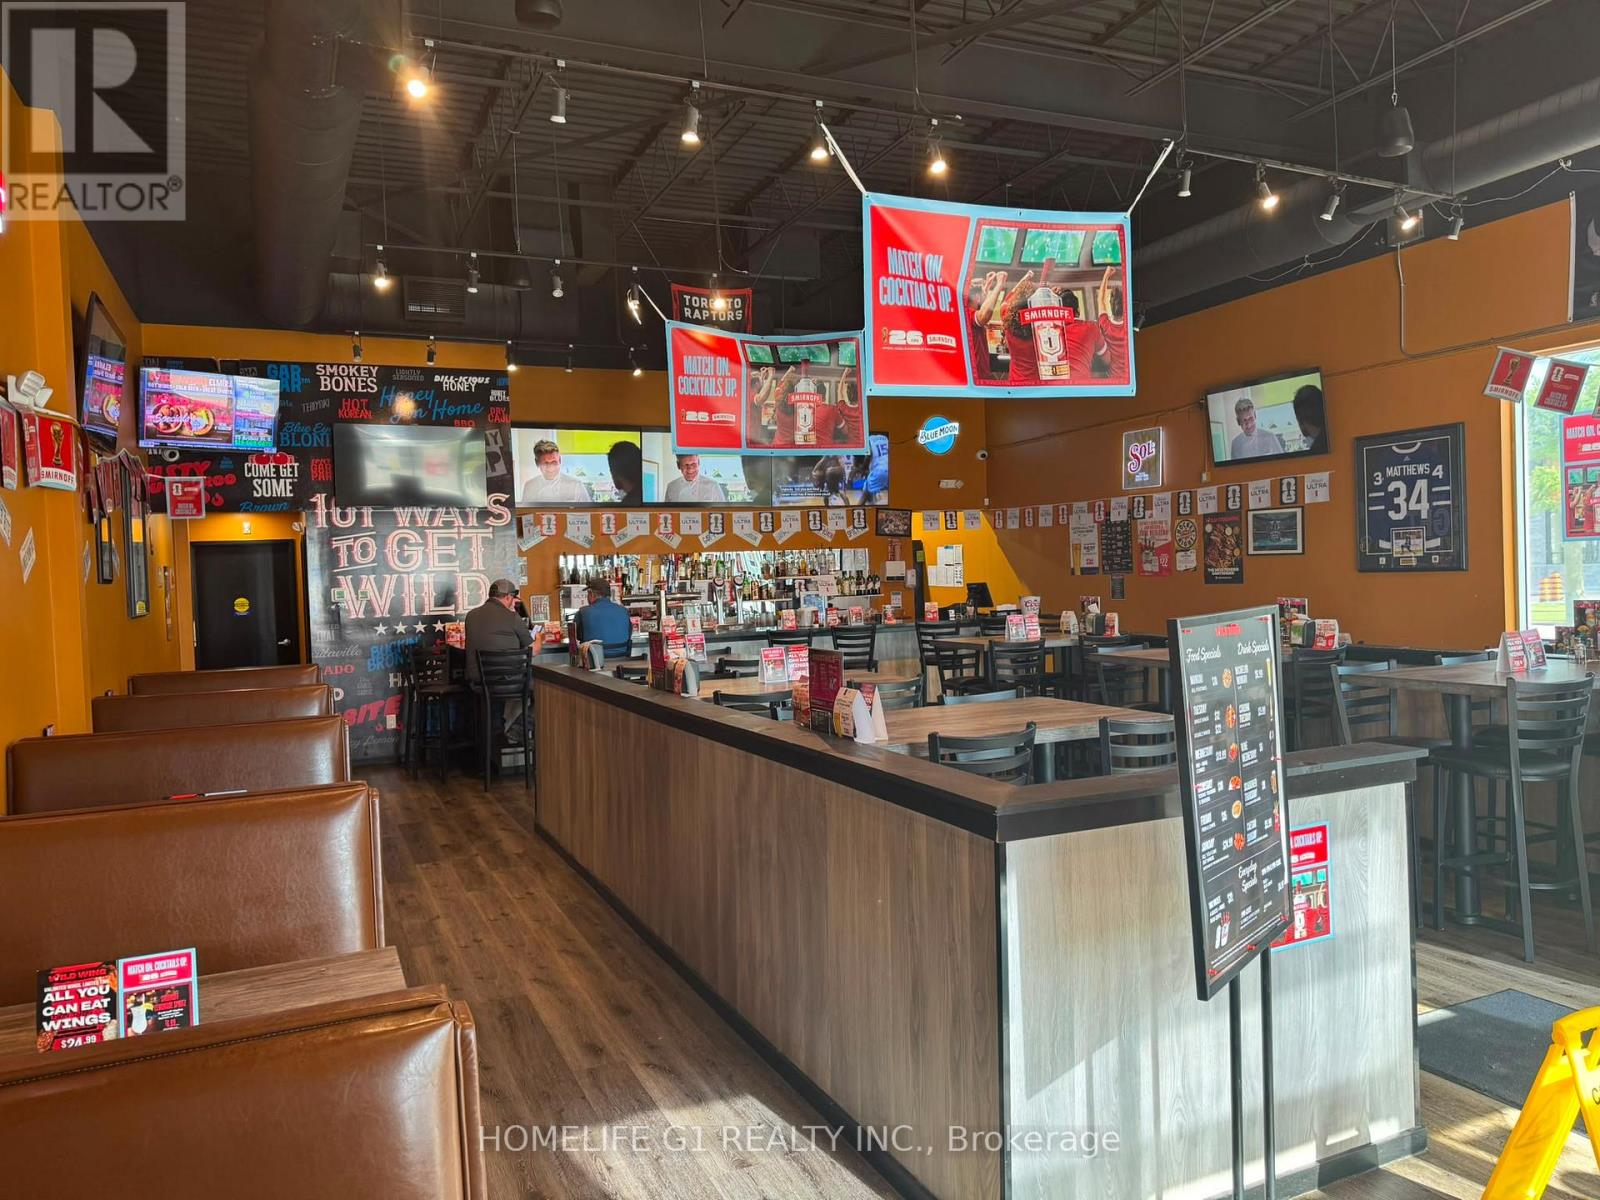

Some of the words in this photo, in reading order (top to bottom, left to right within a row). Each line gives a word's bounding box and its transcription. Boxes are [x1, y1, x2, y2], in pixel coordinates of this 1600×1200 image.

[887, 246, 922, 280] MATCH
[925, 253, 944, 283] ON.
[683, 294, 742, 309] TOROTO
[879, 276, 937, 310] COCKTAILS
[936, 286, 954, 313] UP.
[684, 307, 743, 321] RAPTORS
[315, 364, 379, 378] SMOKEY
[683, 355, 714, 376] MATCH
[319, 377, 379, 393] BONES
[442, 381, 477, 392] HONEY
[678, 375, 723, 397] COCKTAILS
[1489, 384, 1521, 399] SMIRNOFF
[341, 398, 369, 410] HOT
[432, 399, 484, 420] Home
[338, 409, 373, 419] KOREAN
[938, 424, 958, 438] MOON
[40, 470, 74, 484] SMIRNOFF
[244, 462, 277, 477] COME
[280, 462, 300, 477] GET
[1386, 463, 1430, 478] MATTHEWS
[1432, 464, 1444, 479] 4
[252, 478, 294, 498] SOME
[1306, 482, 1327, 490] ULTRA
[1387, 479, 1430, 521] 34
[332, 535, 377, 568] TO
[385, 527, 494, 572] GET
[336, 572, 491, 619] WILD
[1186, 647, 1200, 663] Food
[1200, 644, 1222, 663] Specials
[1237, 642, 1252, 656] Drink
[1251, 639, 1270, 656] Specials
[1238, 859, 1258, 879] Everyday
[1241, 875, 1258, 894] Specials
[78, 967, 107, 979] WING
[42, 989, 75, 1003] ALL
[77, 984, 110, 998] YOU
[42, 1003, 78, 1017] CAN
[81, 998, 111, 1011] EAT
[42, 1012, 111, 1031] WINGS
